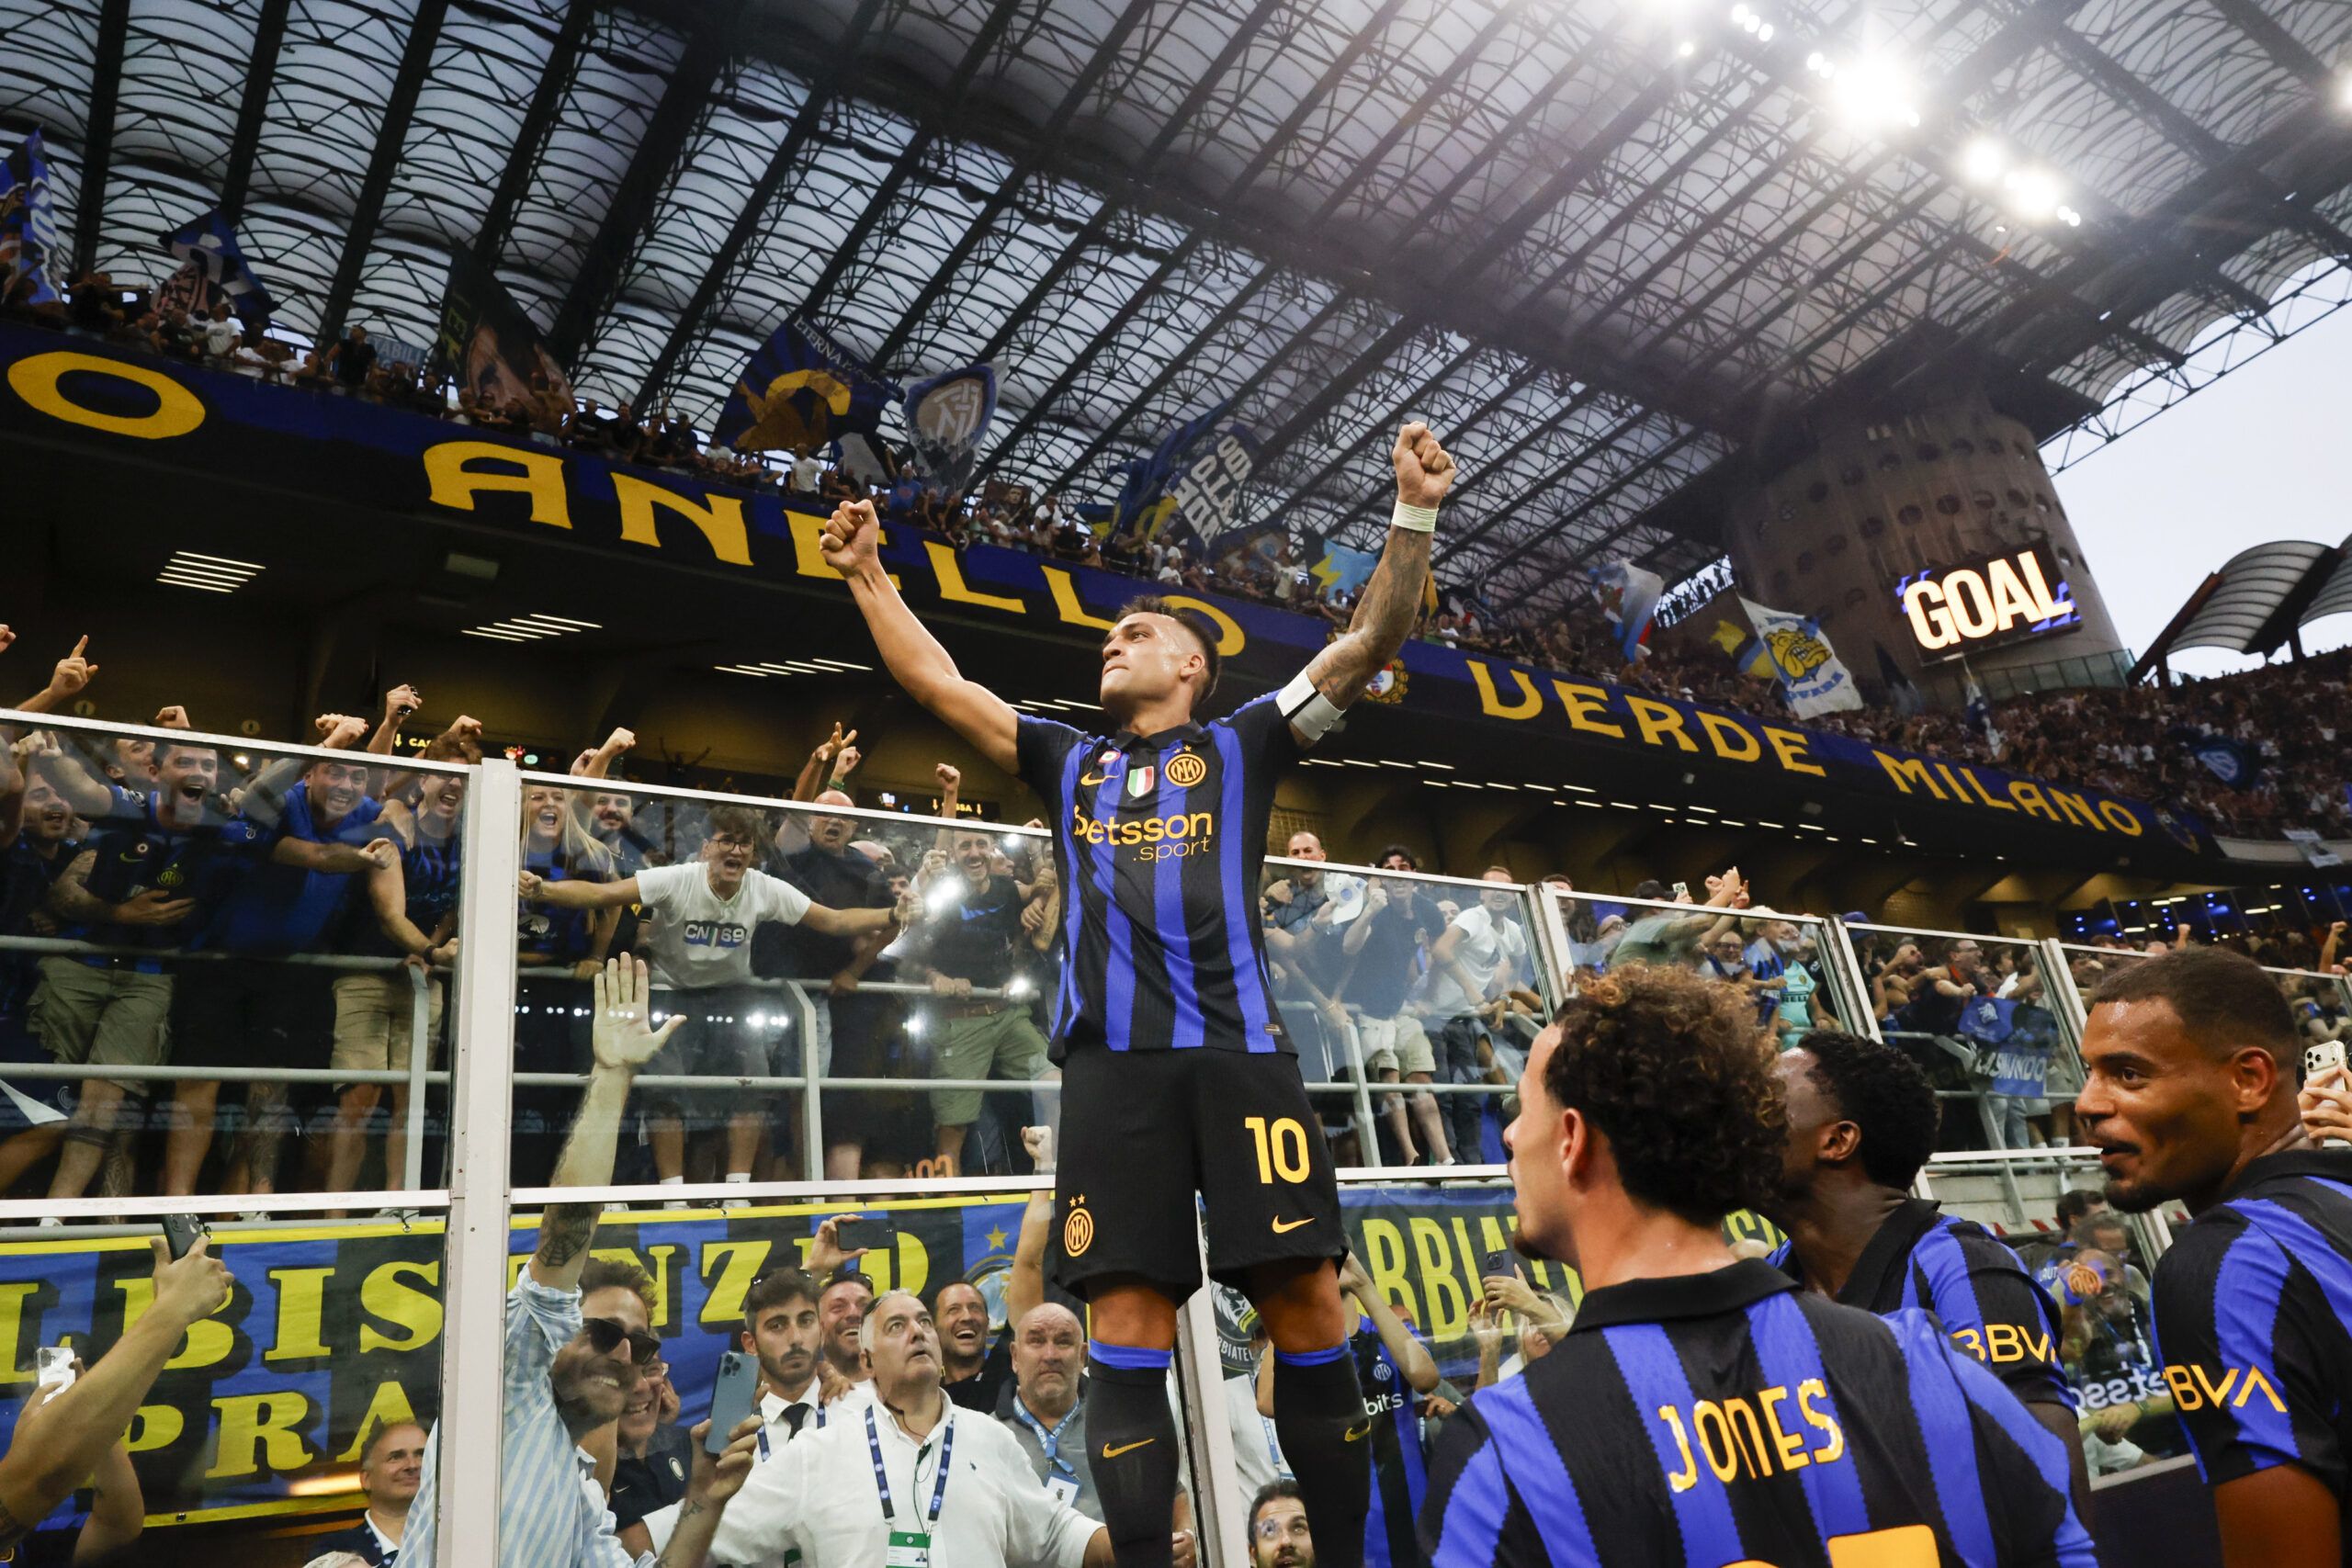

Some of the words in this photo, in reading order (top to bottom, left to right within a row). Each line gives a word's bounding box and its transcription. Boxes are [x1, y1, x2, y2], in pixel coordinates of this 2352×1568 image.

[1903, 550, 2074, 650] GOAL
[1871, 750, 2143, 837] MILANO
[1074, 805, 1213, 846] betsson
[1245, 1117, 1310, 1184] 10
[1951, 1324, 2056, 1363] BBV
[1363, 1393, 1405, 1416] bits
[2161, 1364, 2288, 1413] BVA
[1657, 1378, 1845, 1494] JONES
